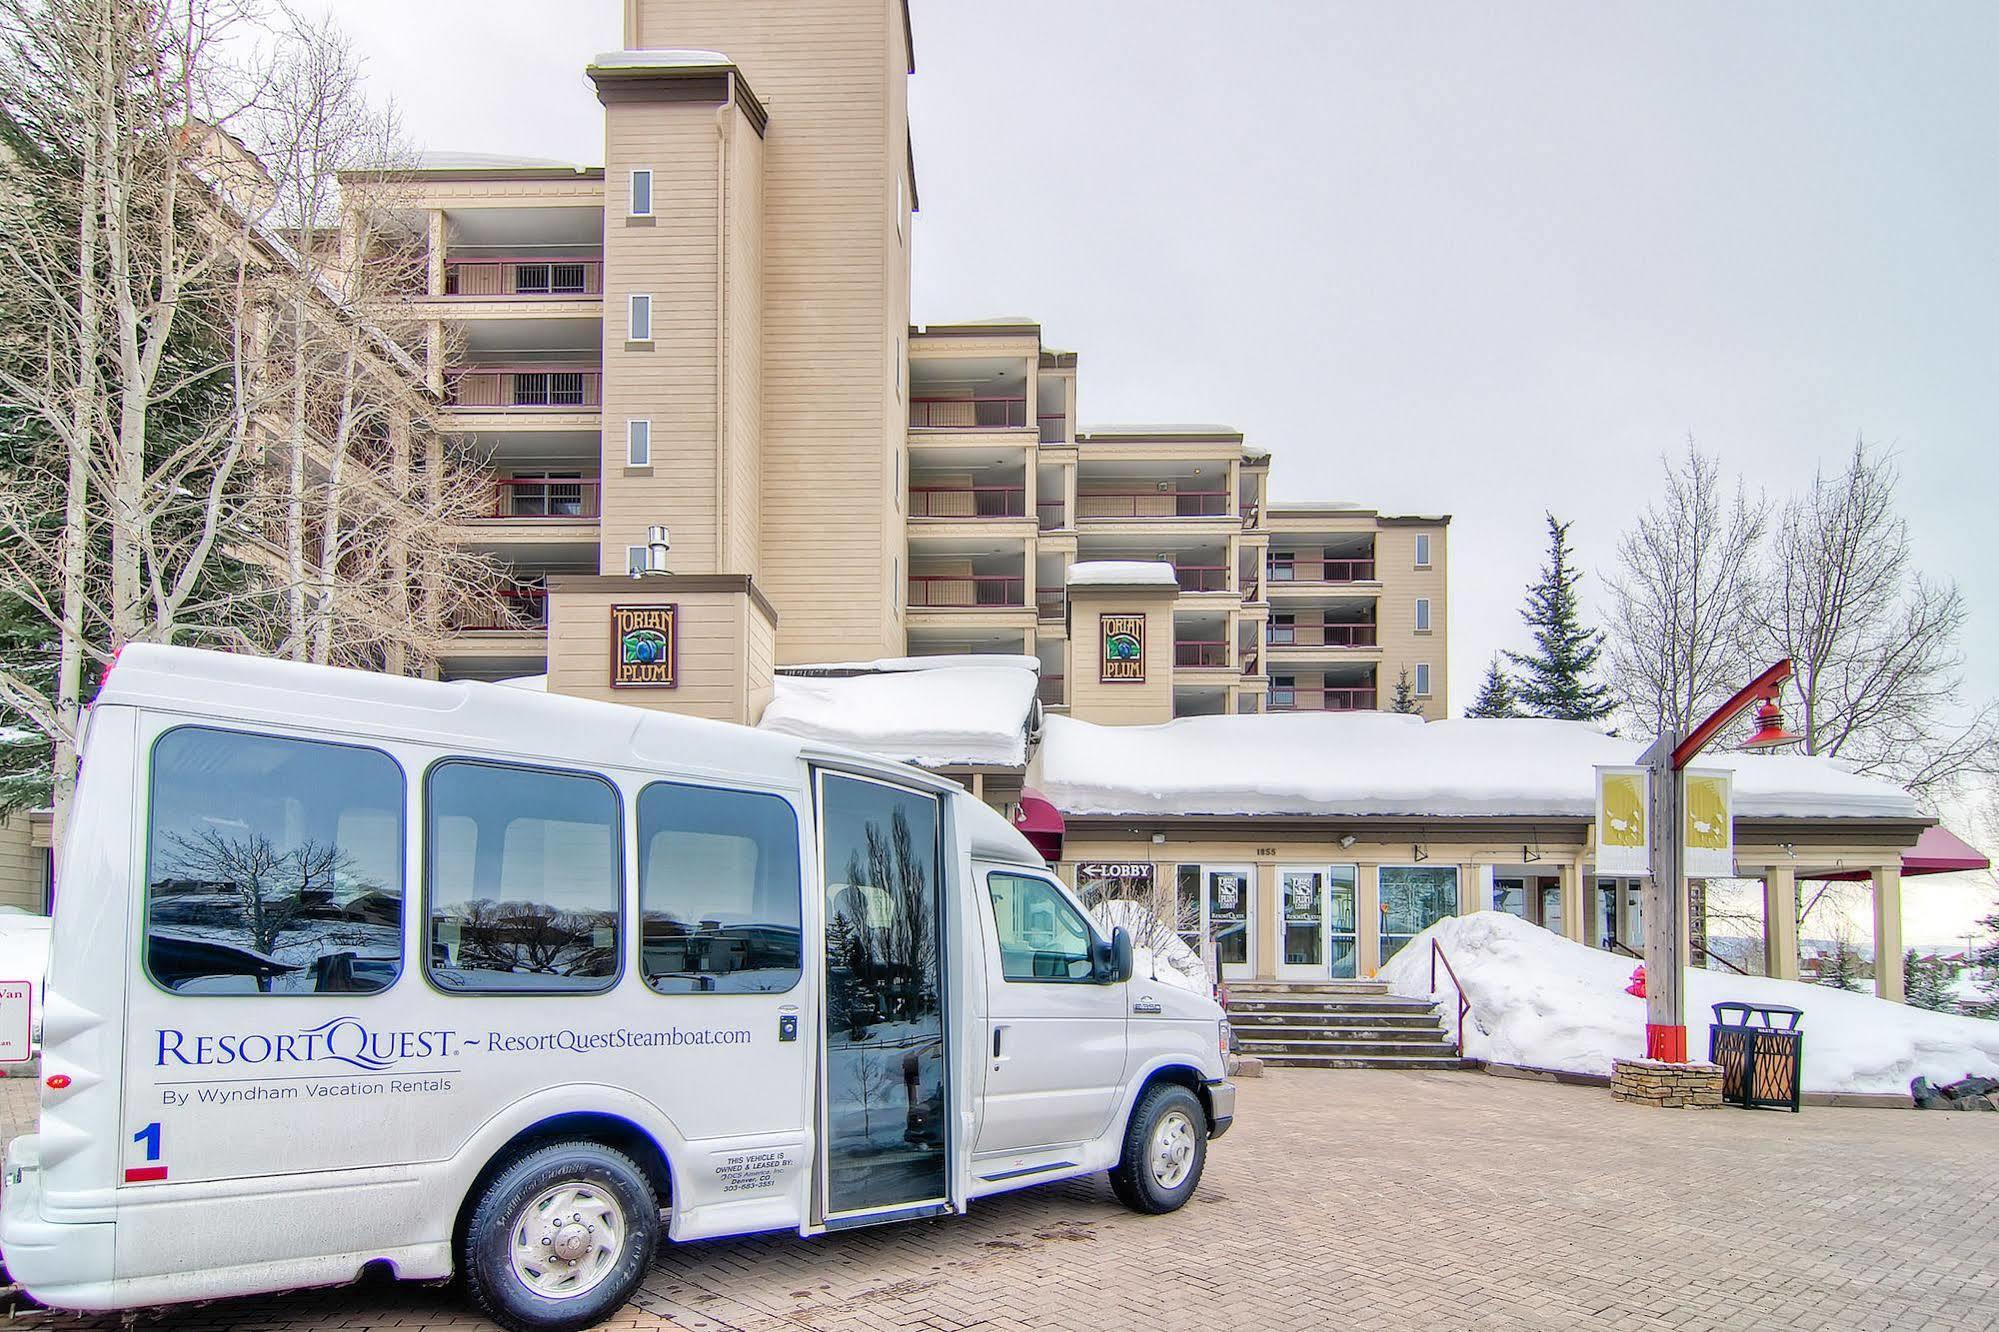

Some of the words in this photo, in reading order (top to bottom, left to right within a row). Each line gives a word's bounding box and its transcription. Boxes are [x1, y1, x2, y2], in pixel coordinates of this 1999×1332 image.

[613, 609, 673, 632] TORIAN
[1101, 618, 1145, 640] TORIAN
[621, 664, 668, 682] PLUM
[1106, 662, 1140, 677] PLUM
[1256, 847, 1277, 856] 1855
[1101, 864, 1151, 877] LOBBY
[487, 1026, 752, 1053] ResortQuestSteamboat.com
[163, 1090, 189, 1107] By
[198, 1085, 298, 1104] Wyndham
[305, 1081, 384, 1097] Vacation
[390, 1078, 451, 1093] Rentals
[133, 1122, 162, 1161] 1
[727, 1156, 743, 1165] THIS
[746, 1153, 774, 1163] VEHICLE
[777, 1152, 784, 1160] IS
[715, 1164, 742, 1174] OWNED
[744, 1163, 750, 1171] &
[752, 1160, 780, 1170] LEASED
[731, 1177, 757, 1185] Denver,
[760, 1174, 771, 1182] CO
